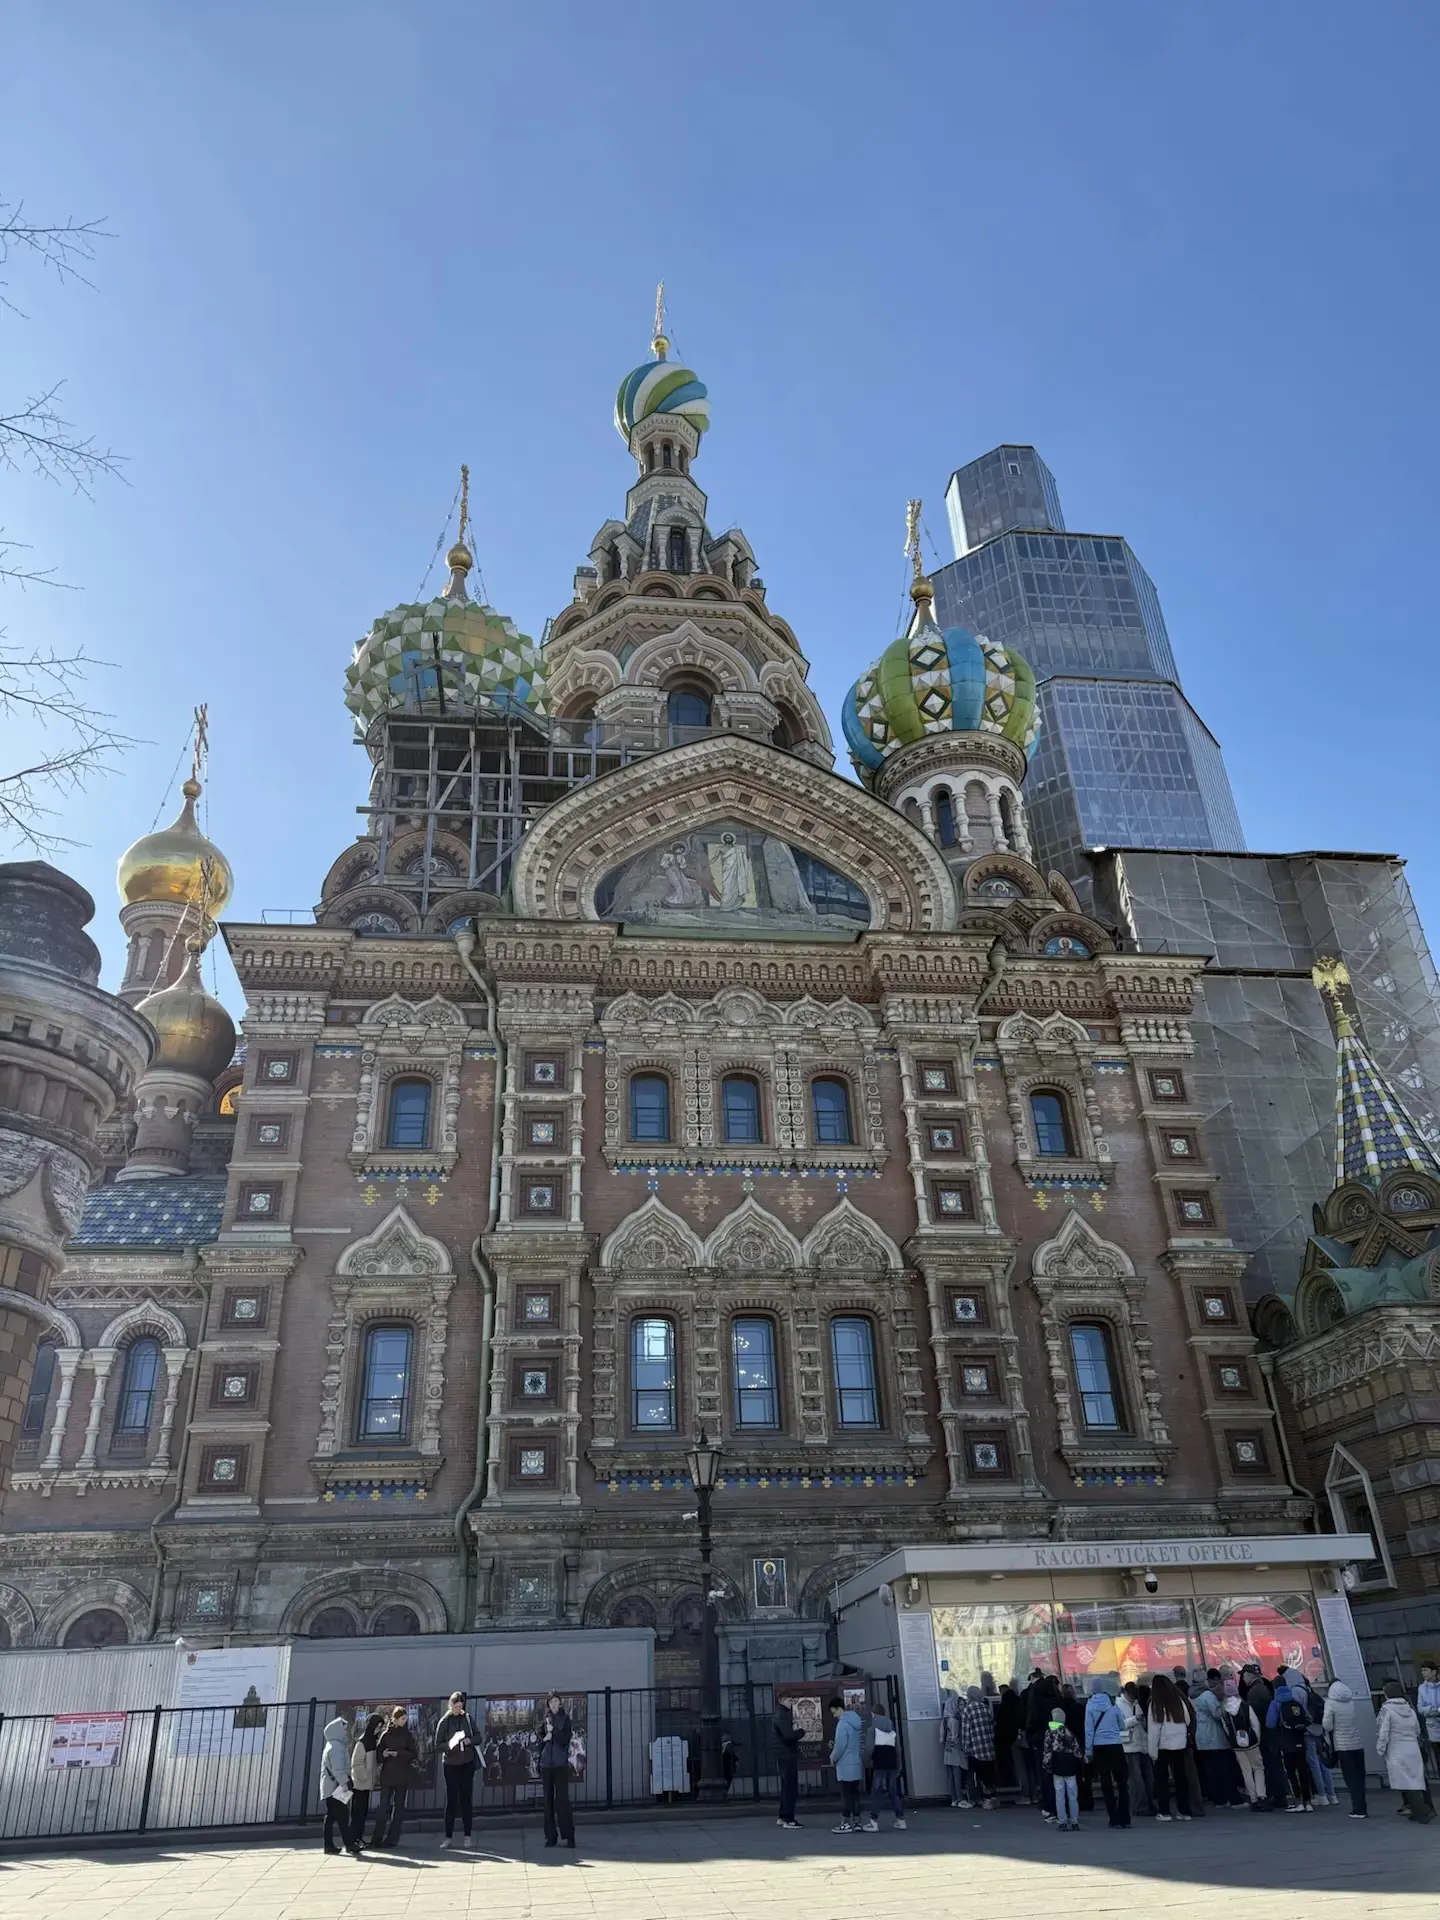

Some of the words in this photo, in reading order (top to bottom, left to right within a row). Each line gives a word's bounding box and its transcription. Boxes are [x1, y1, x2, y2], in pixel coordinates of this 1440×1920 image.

[1033, 1548, 1101, 1566] КАССЫ
[1113, 1546, 1181, 1564] TICKET
[1187, 1544, 1253, 1561] OFFICE
